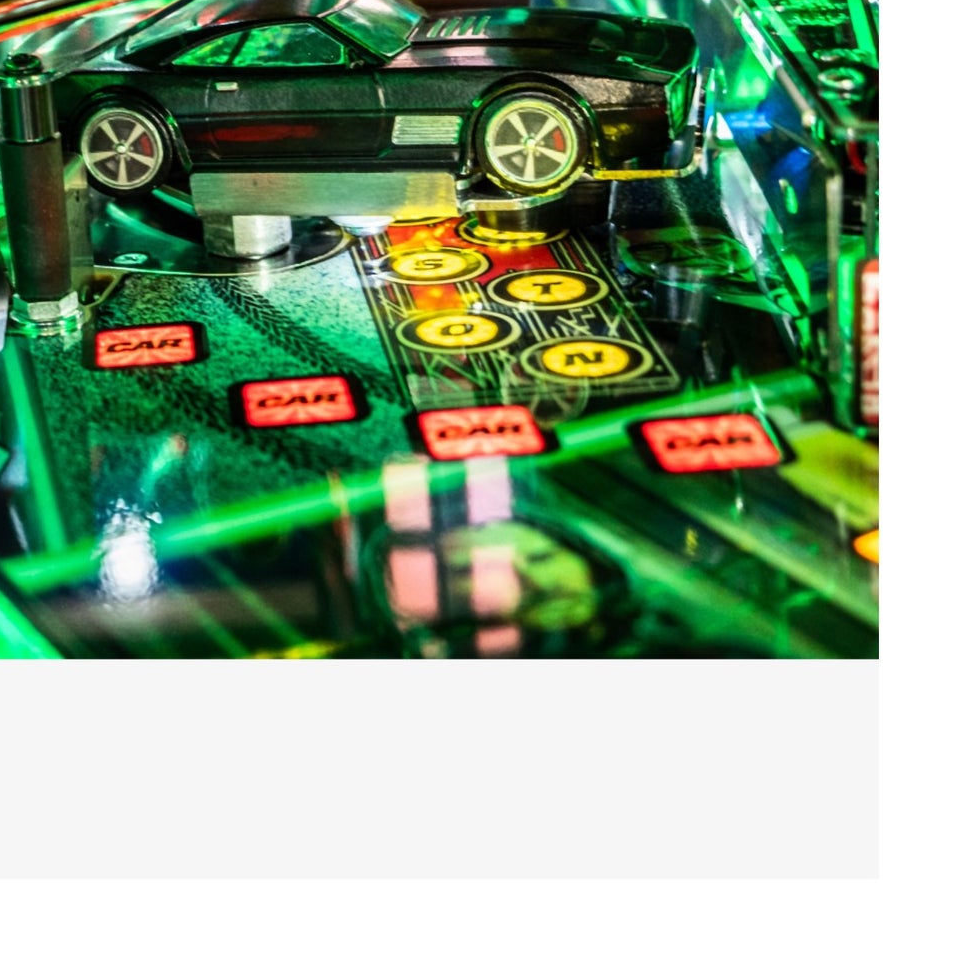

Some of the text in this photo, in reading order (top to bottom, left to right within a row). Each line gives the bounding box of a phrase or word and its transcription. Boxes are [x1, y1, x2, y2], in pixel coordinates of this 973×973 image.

[414, 258, 443, 271] S
[532, 281, 563, 295] T
[440, 323, 473, 337] O
[105, 338, 183, 354] CAR
[564, 350, 604, 367] N
[256, 392, 340, 409] CAR
[436, 423, 522, 439] CAR
[665, 433, 754, 449] CAR
